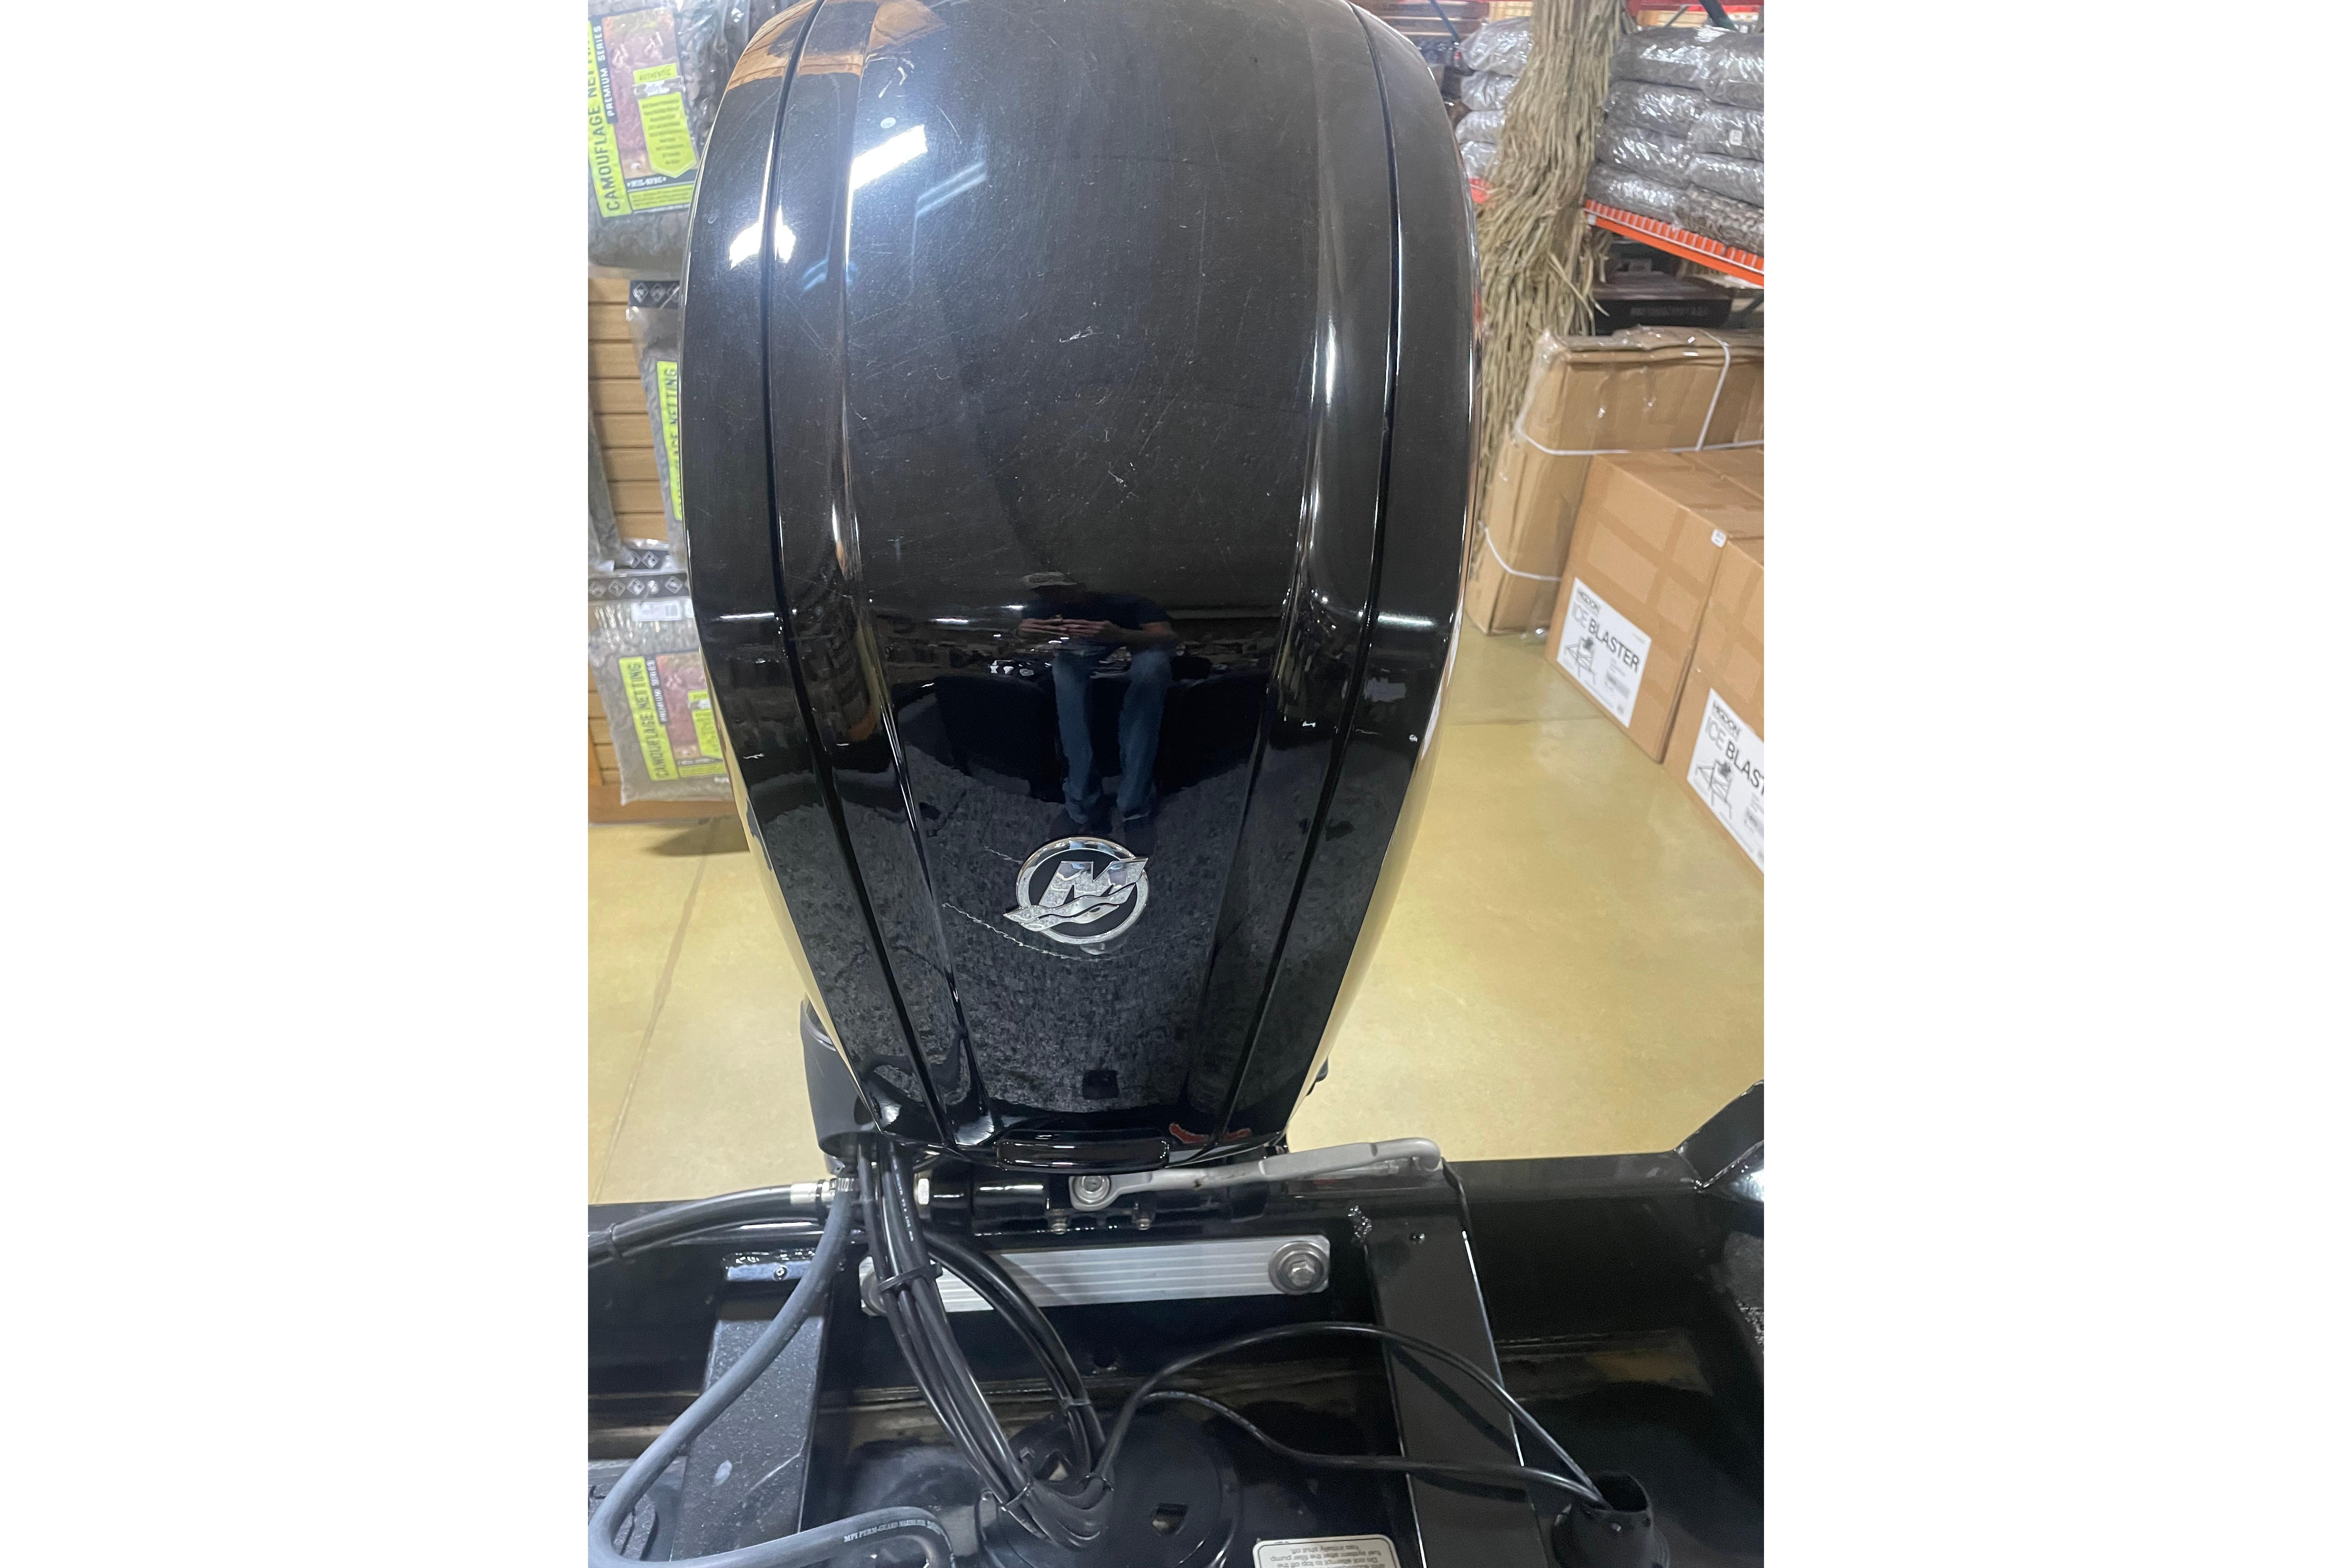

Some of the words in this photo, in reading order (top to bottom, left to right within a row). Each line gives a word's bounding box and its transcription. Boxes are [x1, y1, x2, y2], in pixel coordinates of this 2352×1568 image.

[593, 25, 606, 61] SERIES
[600, 68, 615, 117] PREMIUM
[588, 105, 620, 211] CAMOUFLAGE
[1589, 618, 1640, 674] BLASTER
[1705, 716, 1727, 751] ICE
[844, 1532, 858, 1543] MPI
